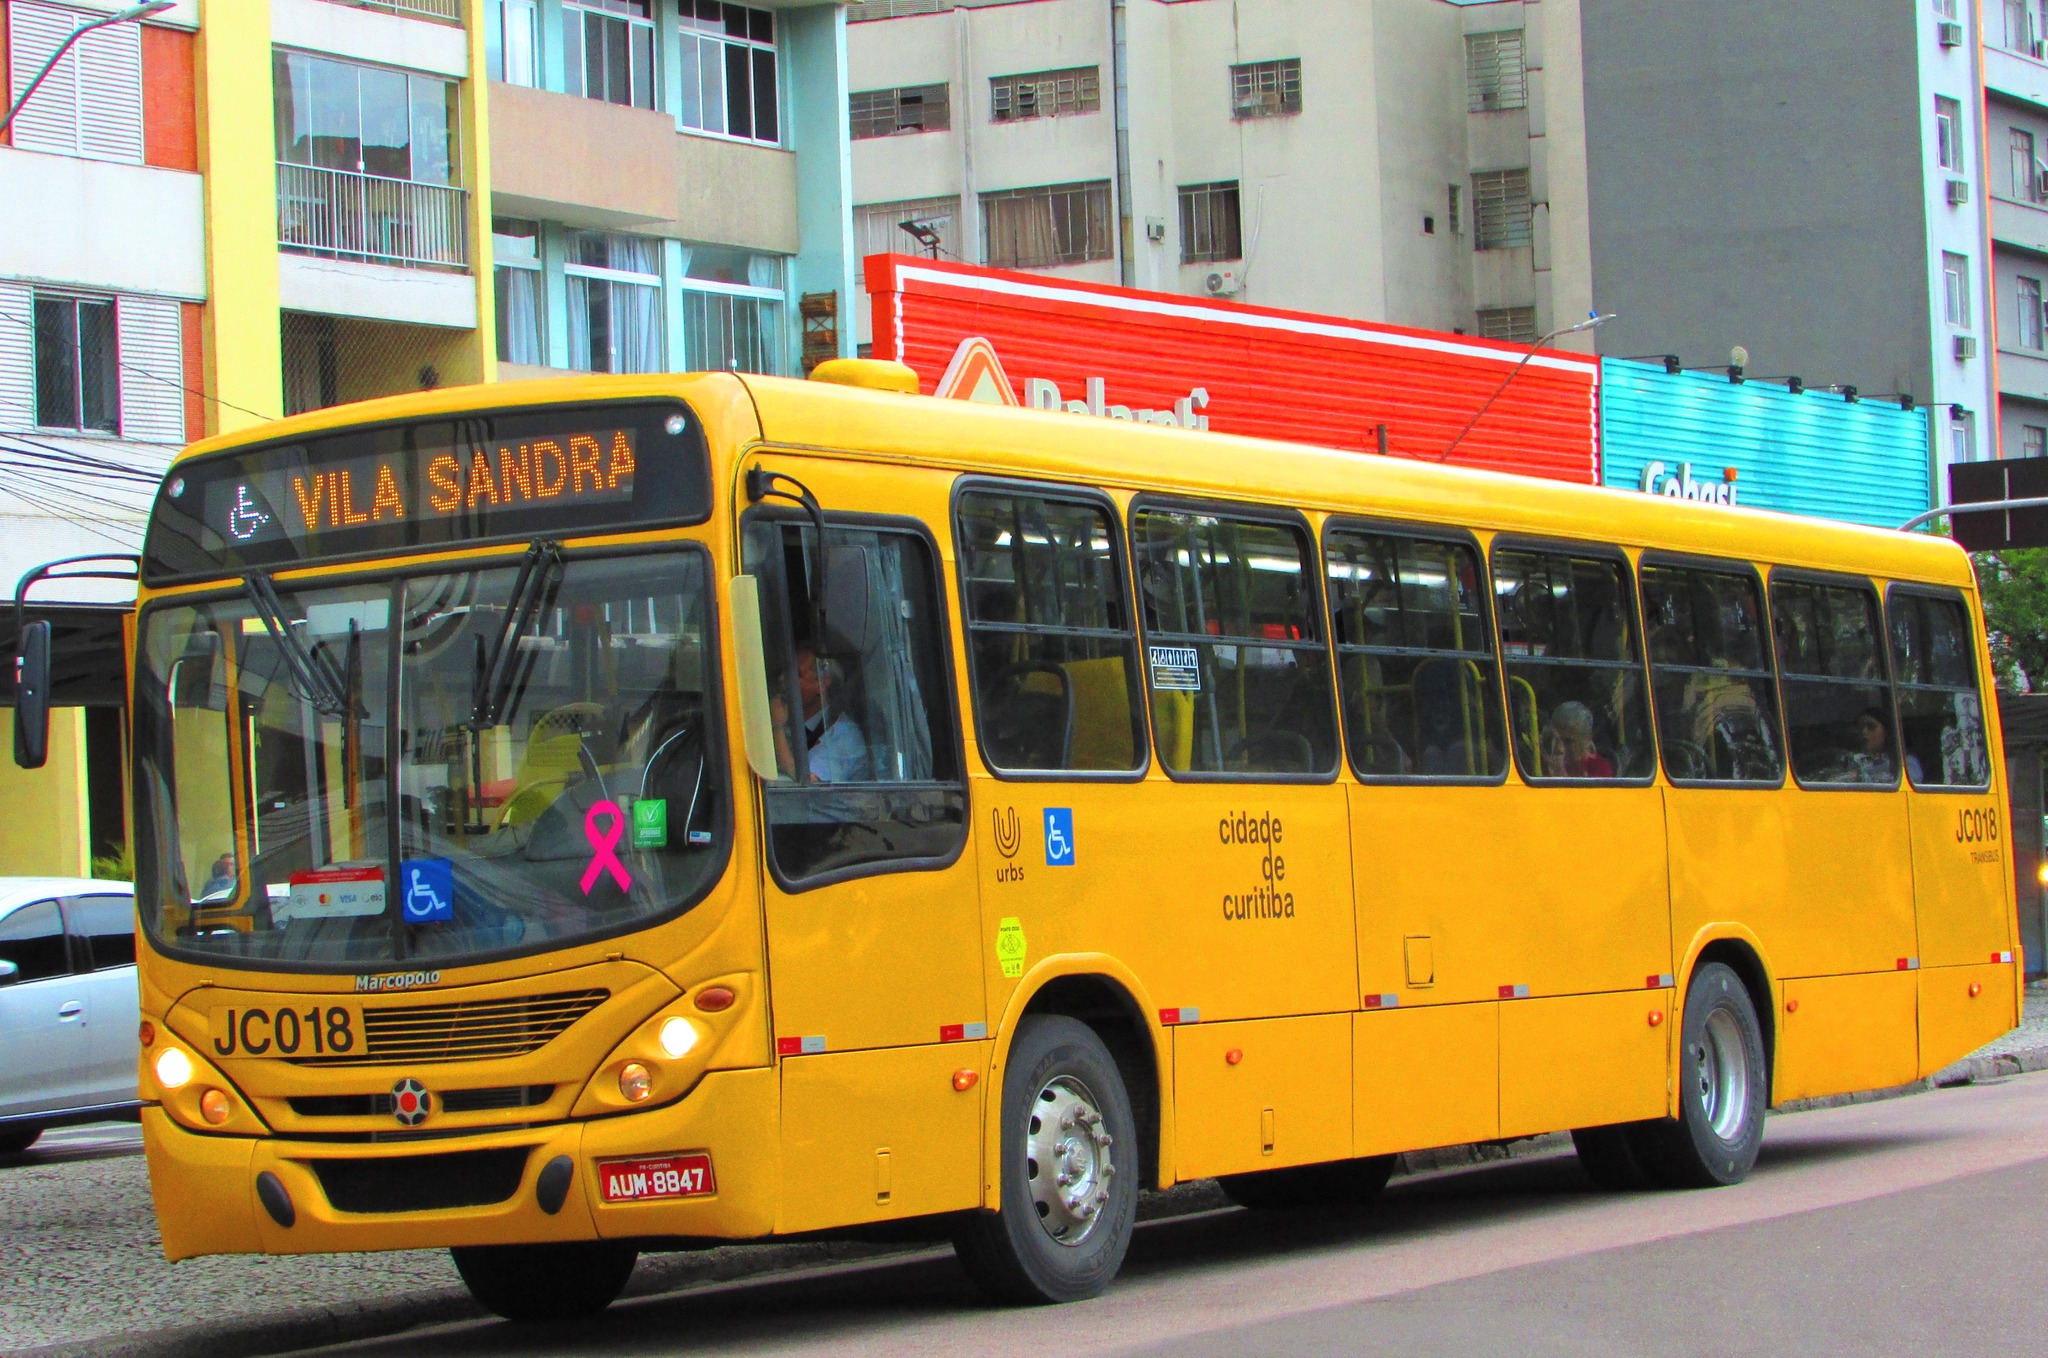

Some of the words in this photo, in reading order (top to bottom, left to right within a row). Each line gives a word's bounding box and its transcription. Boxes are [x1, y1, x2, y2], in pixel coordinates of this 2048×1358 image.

[293, 464, 403, 530] VILA
[428, 430, 636, 512] SANDRA
[1219, 810, 1283, 844] cidade
[1956, 807, 1997, 843] JC018
[996, 862, 1024, 883] urbs
[1261, 845, 1286, 880] de
[340, 894, 357, 903] VISA
[1222, 885, 1295, 920] curitiba
[355, 970, 441, 992] Marcopolo
[214, 1006, 354, 1056] JC018
